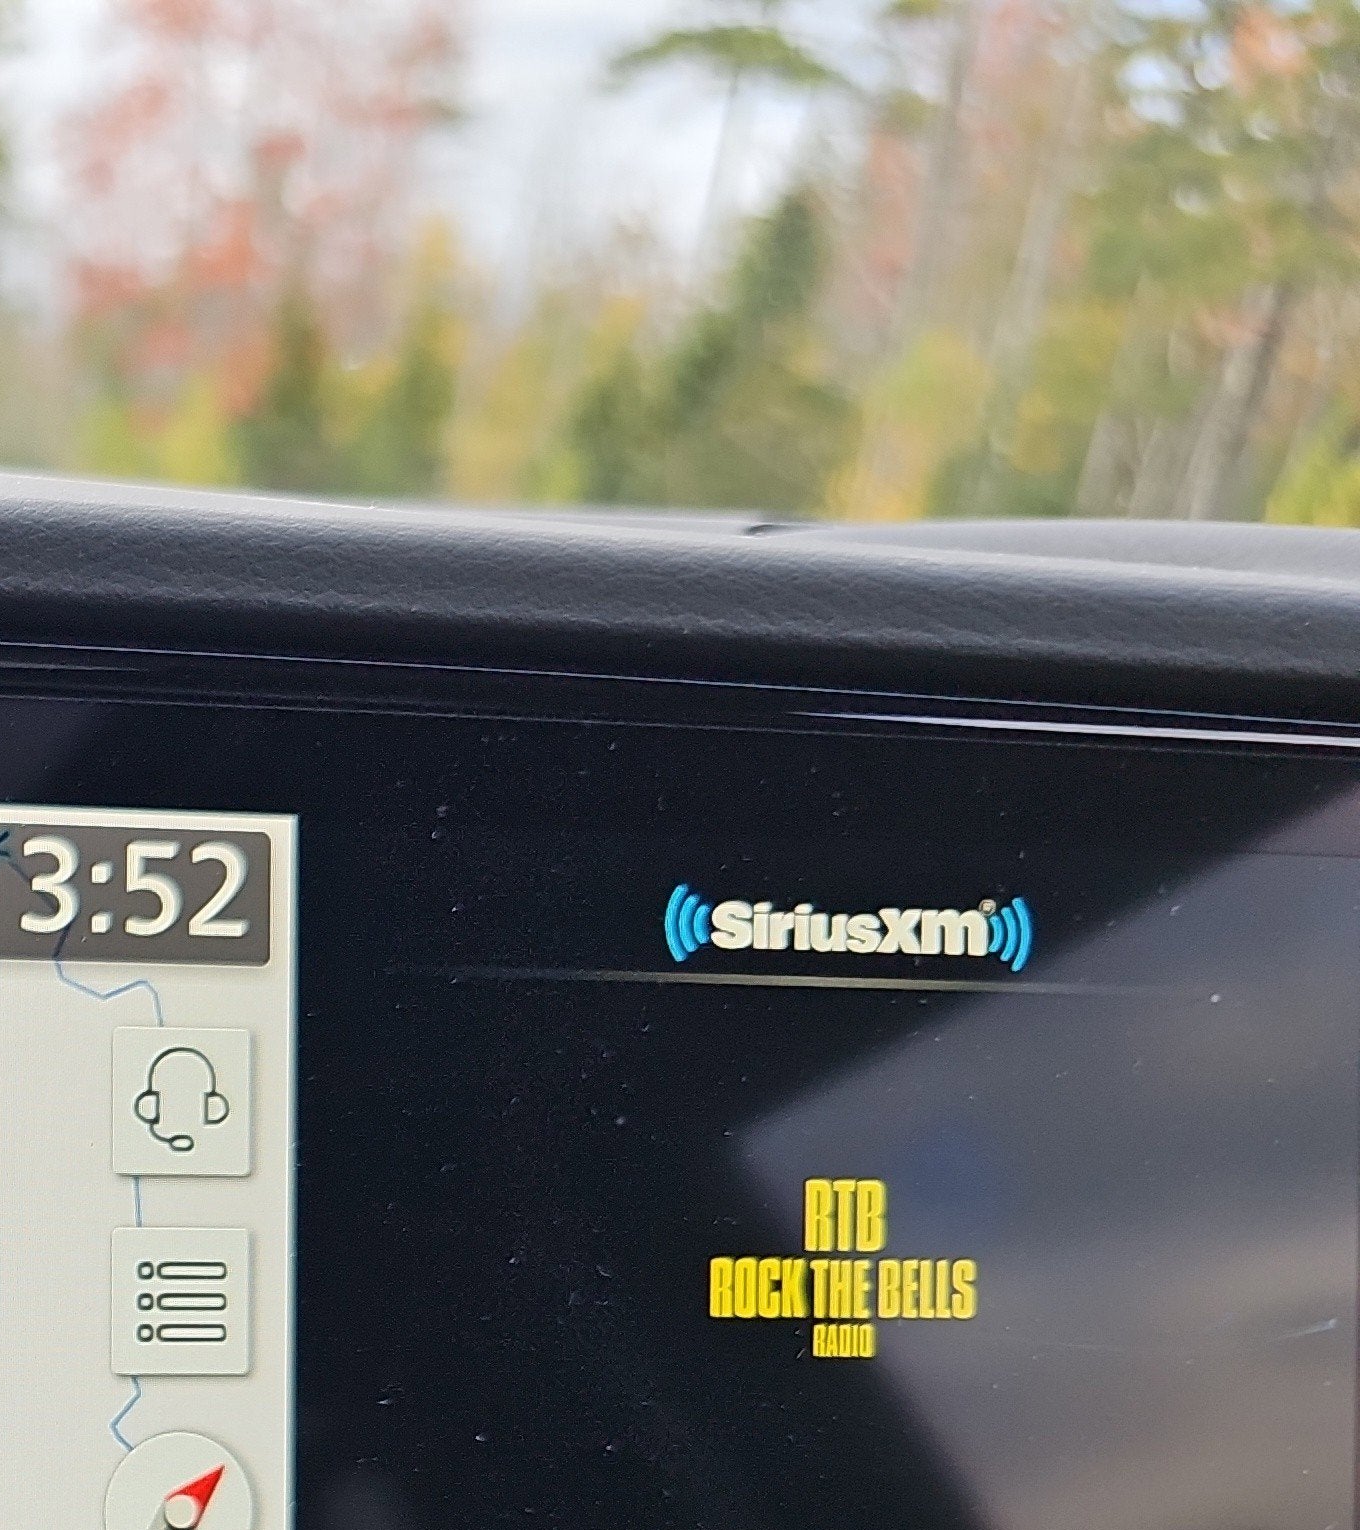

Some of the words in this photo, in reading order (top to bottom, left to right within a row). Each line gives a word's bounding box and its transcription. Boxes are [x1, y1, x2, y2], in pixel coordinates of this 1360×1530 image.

[20, 834, 249, 938] 3:52
[805, 1178, 886, 1252] RTB
[710, 1258, 806, 1318] ROCK
[810, 1259, 871, 1319] THE
[878, 1259, 977, 1318] BELLS
[813, 1324, 875, 1357] RADIO
